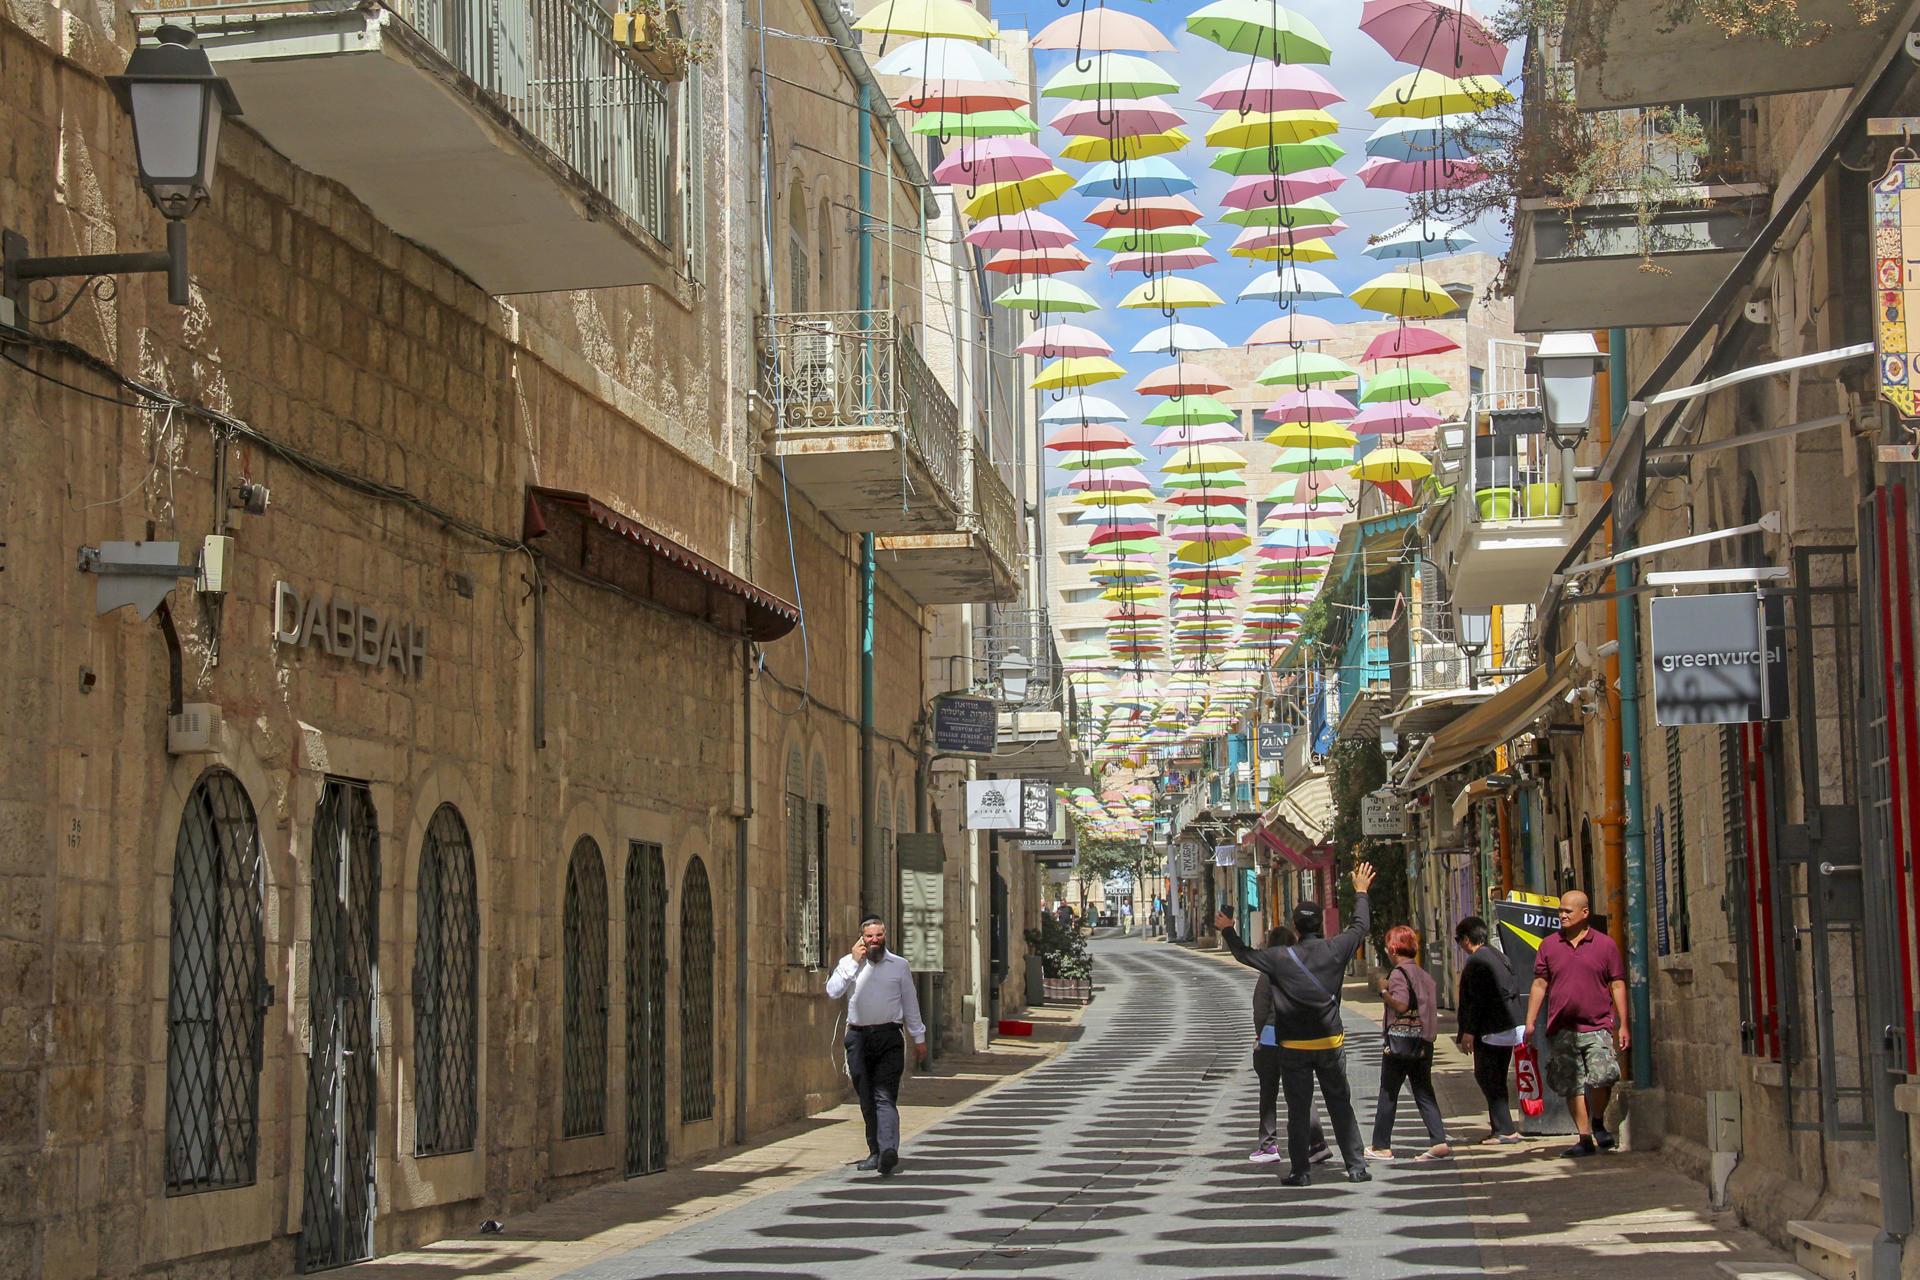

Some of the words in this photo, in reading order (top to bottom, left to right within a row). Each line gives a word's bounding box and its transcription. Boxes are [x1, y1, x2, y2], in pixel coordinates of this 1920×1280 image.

[273, 580, 429, 680] DABBAH
[72, 818, 82, 833] 36
[67, 833, 81, 849] 167
